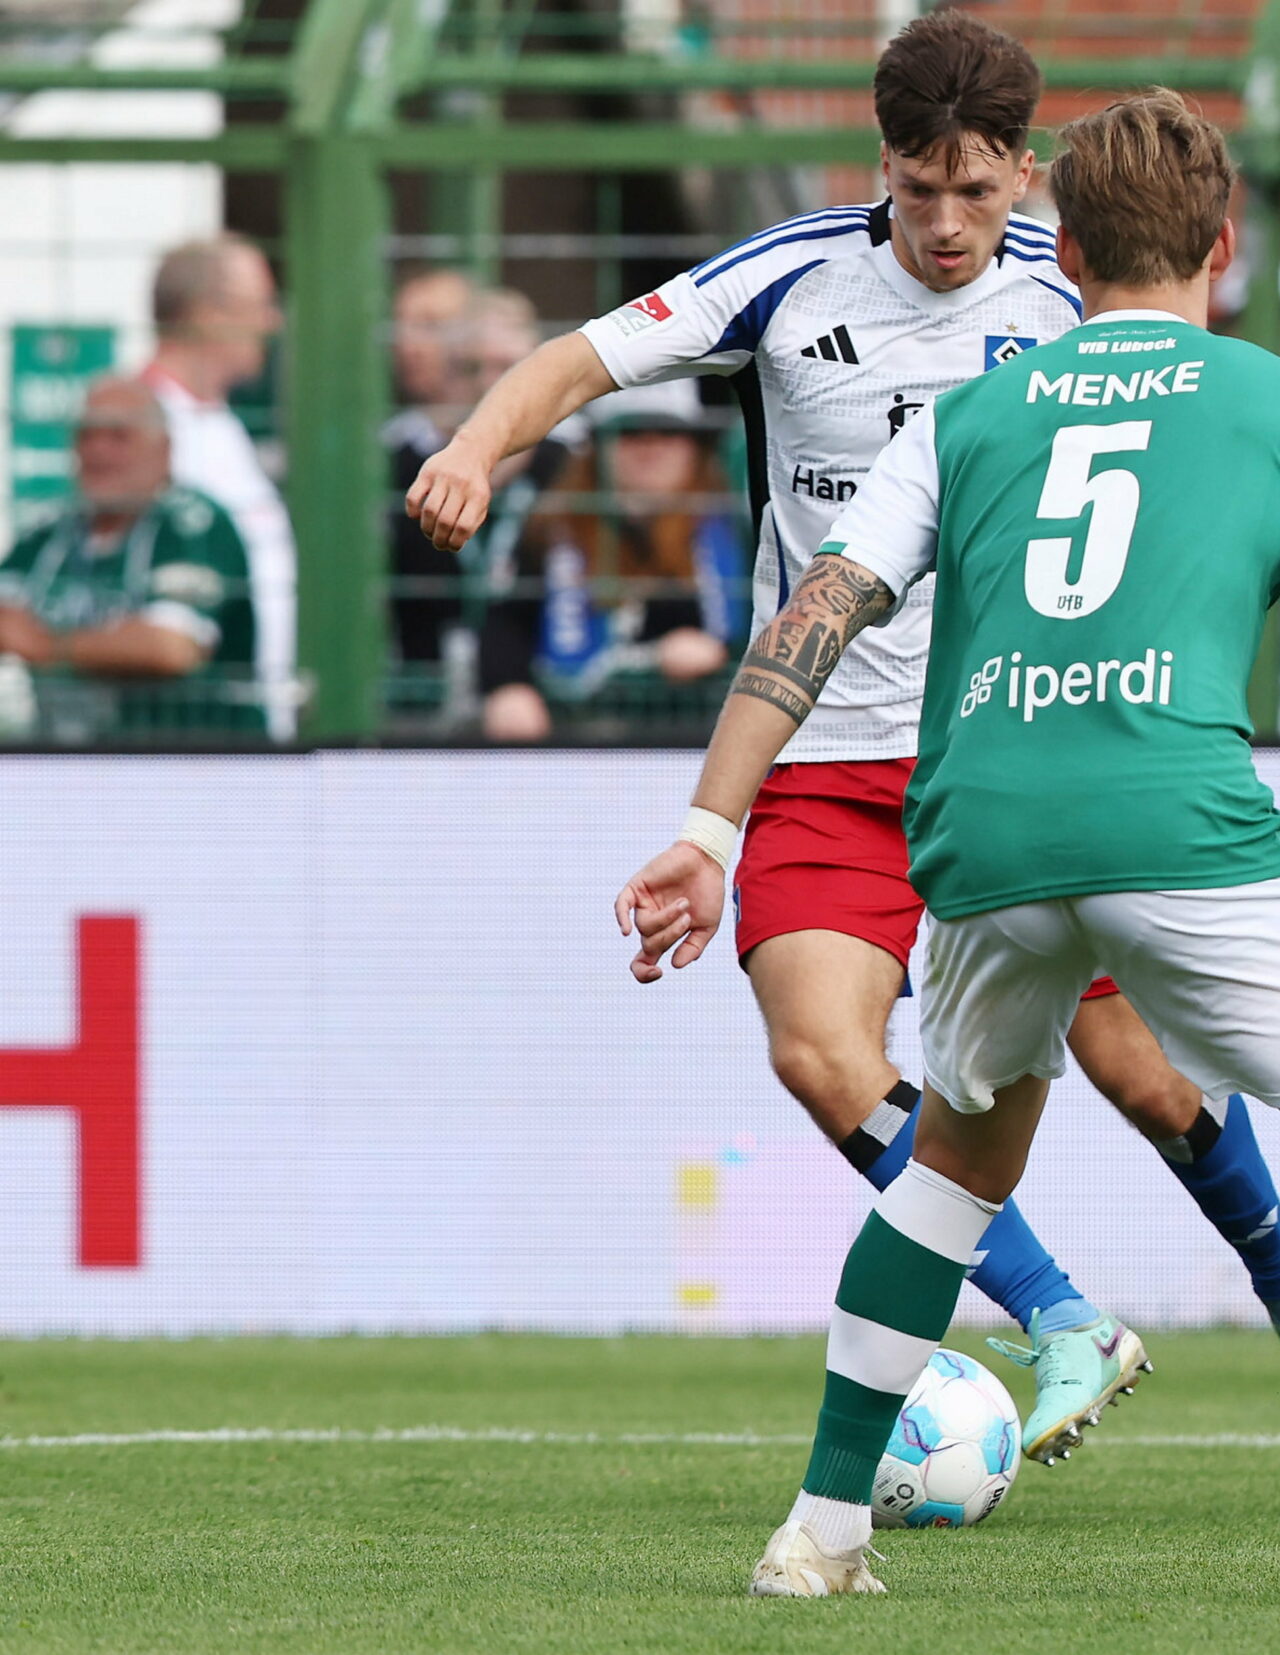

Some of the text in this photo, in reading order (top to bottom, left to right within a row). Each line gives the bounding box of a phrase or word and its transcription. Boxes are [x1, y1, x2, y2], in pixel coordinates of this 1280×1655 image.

[1025, 360, 1205, 406] MENKE
[1024, 420, 1153, 620] 5
[1008, 648, 1174, 722] iperdi
